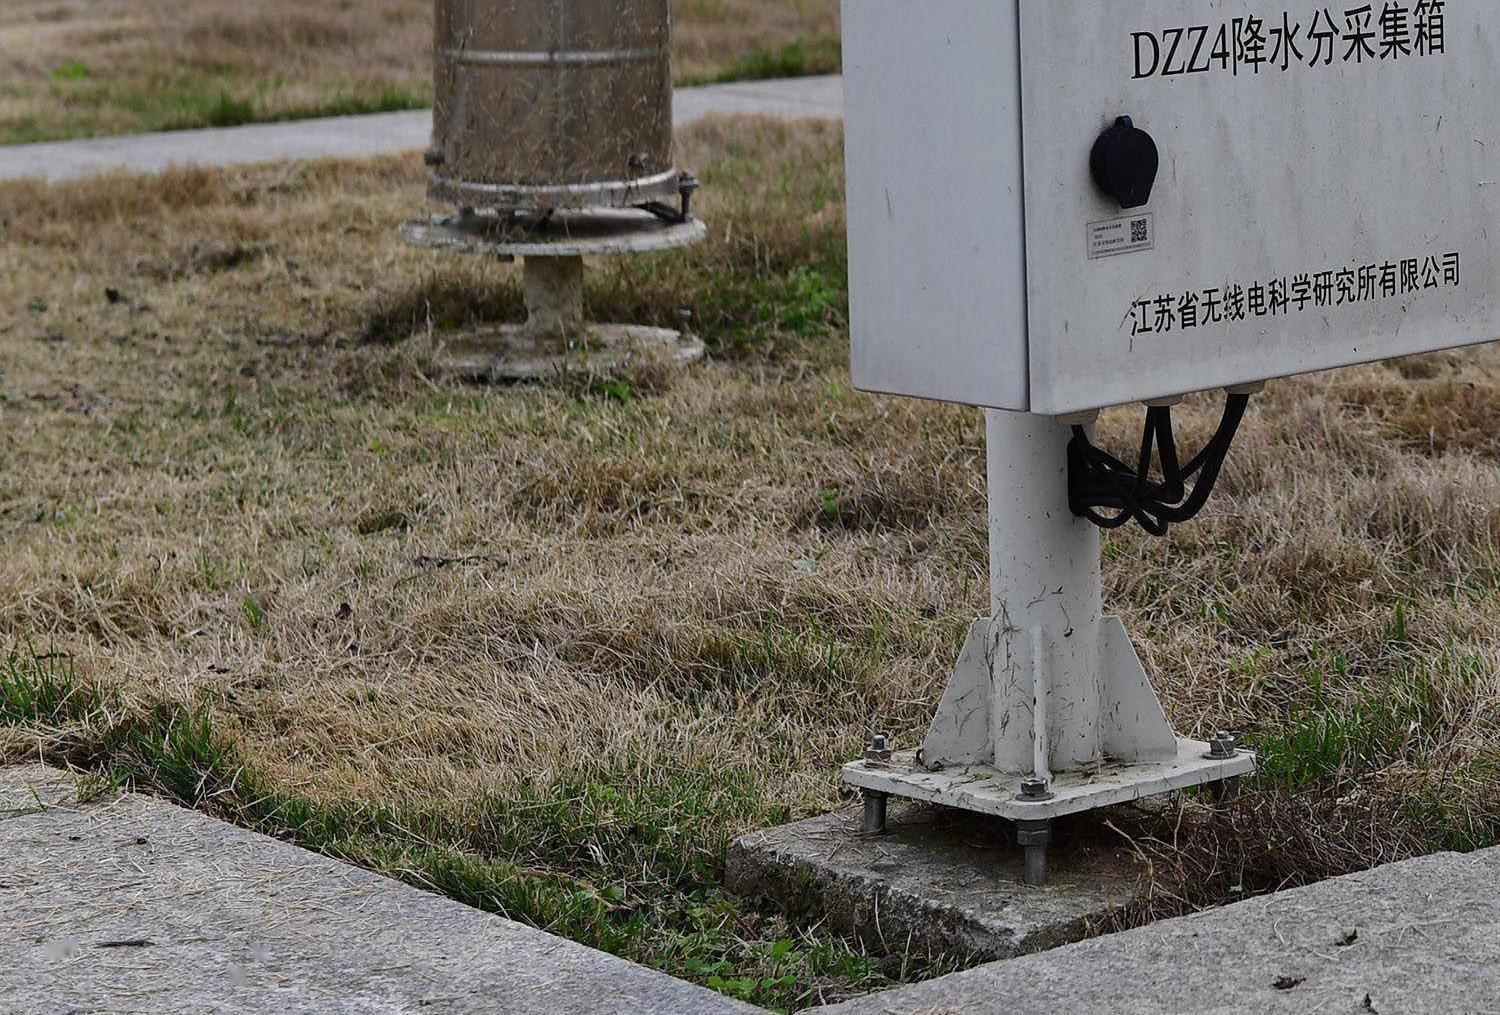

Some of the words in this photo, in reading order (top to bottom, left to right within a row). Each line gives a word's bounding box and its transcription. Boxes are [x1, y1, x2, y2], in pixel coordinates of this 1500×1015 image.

[1130, 252, 1460, 336] 江苏省无线电科学研究所有限公司
